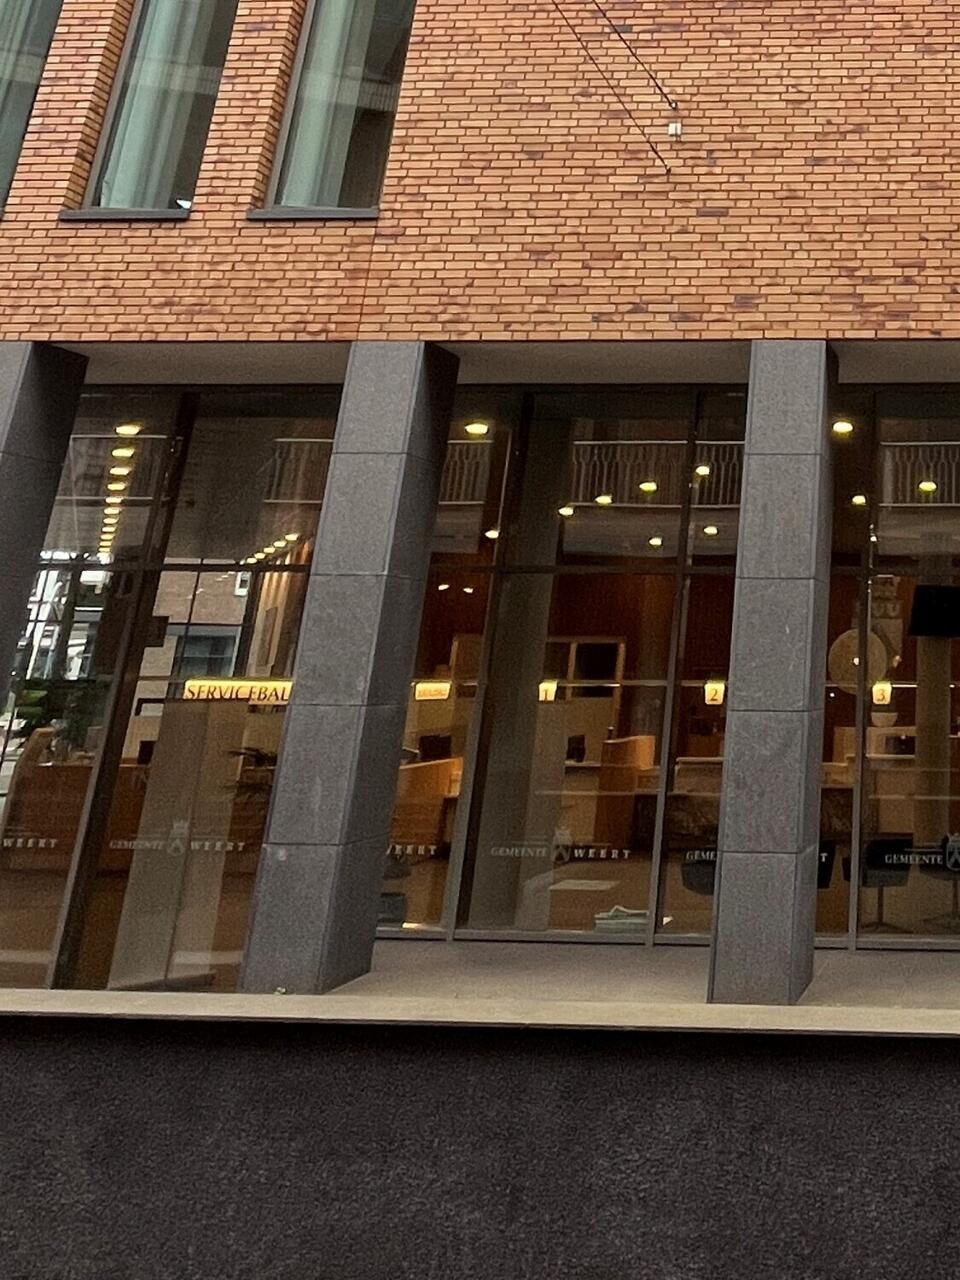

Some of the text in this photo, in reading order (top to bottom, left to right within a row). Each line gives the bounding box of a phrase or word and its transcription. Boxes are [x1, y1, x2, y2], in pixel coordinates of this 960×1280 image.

[709, 688, 719, 702] 2
[876, 688, 886, 702] 3
[573, 848, 632, 860] WEERT
[884, 853, 944, 865] GEMEENTE
